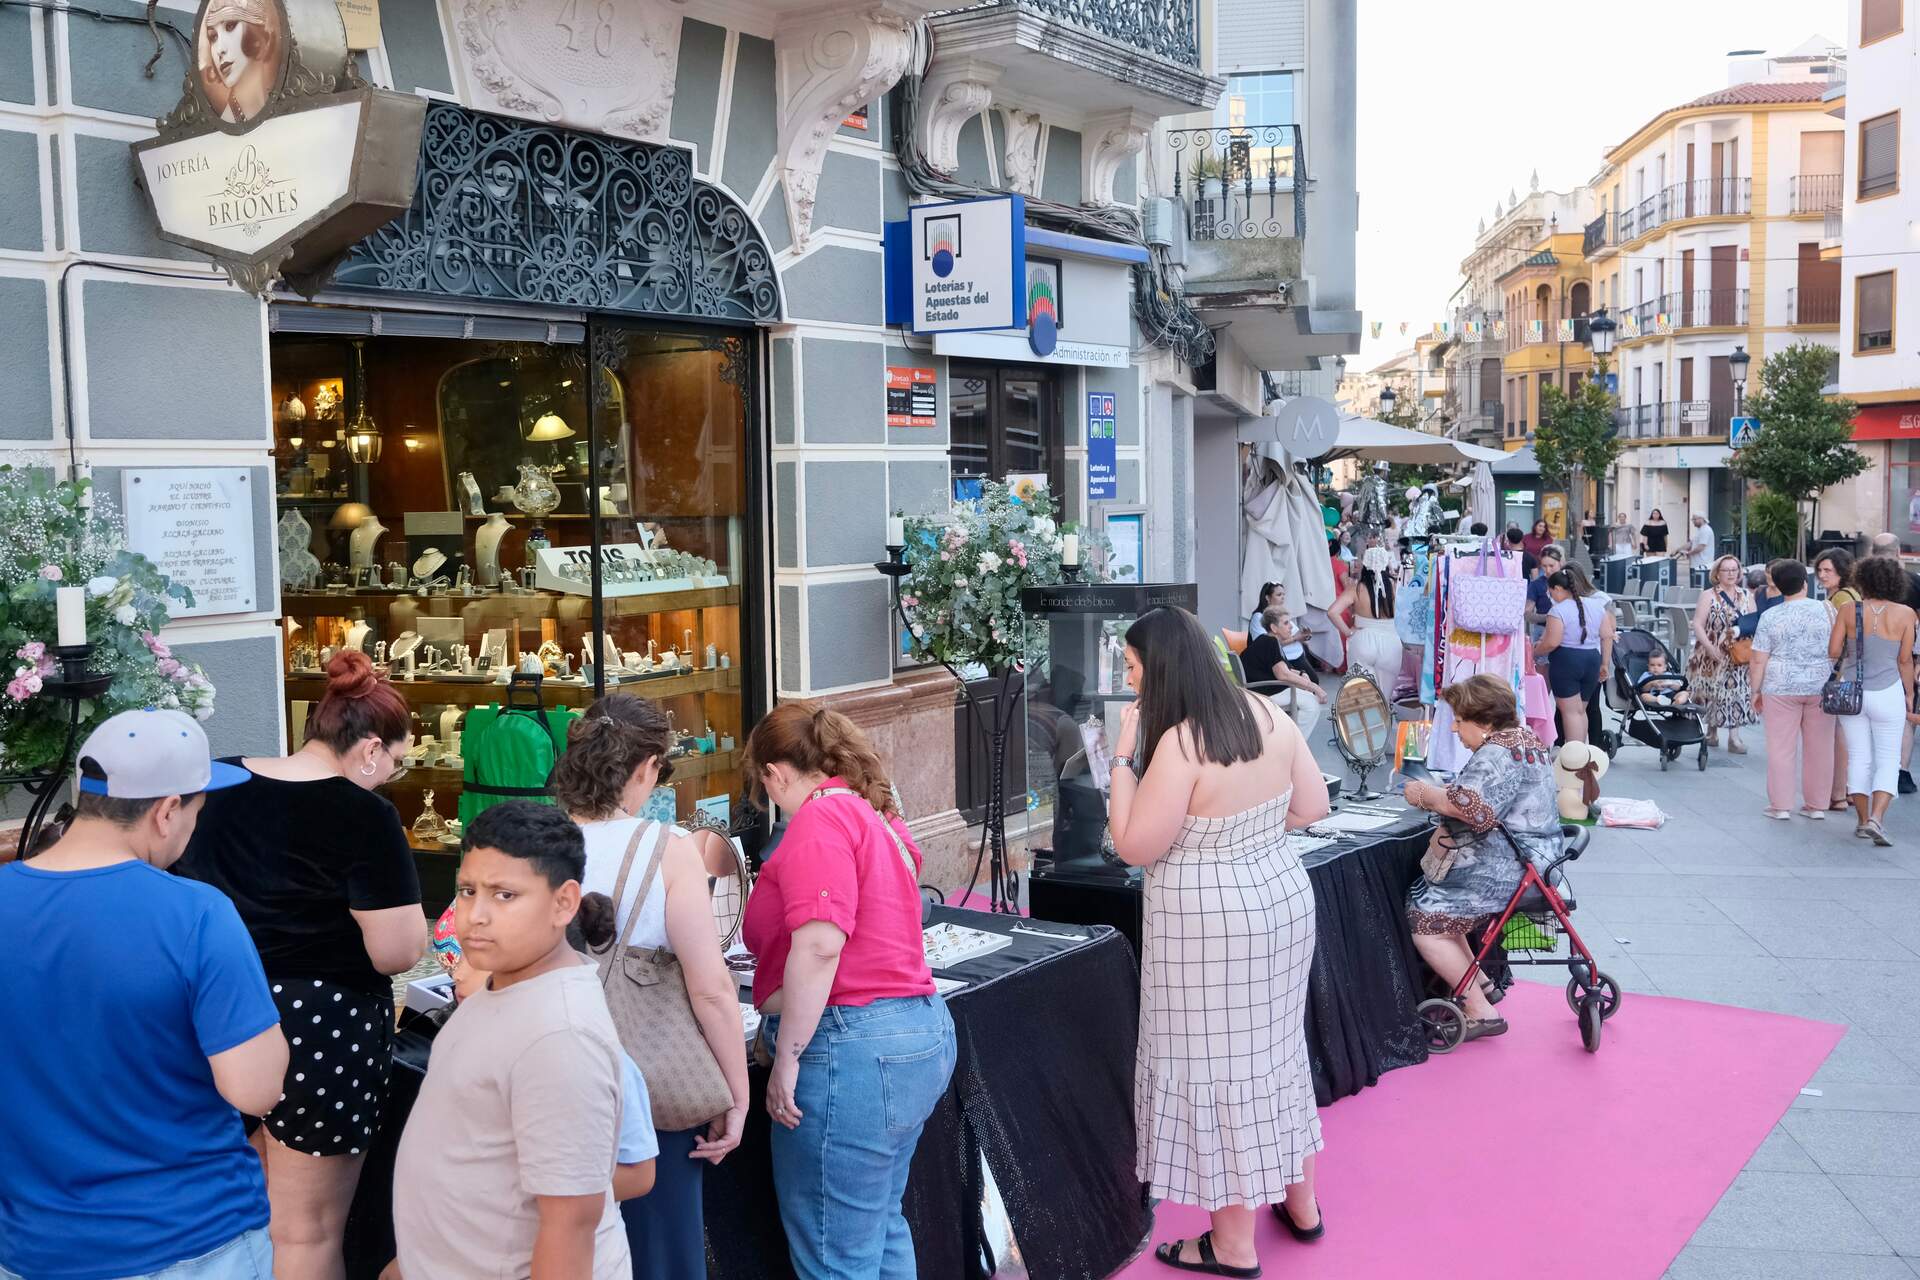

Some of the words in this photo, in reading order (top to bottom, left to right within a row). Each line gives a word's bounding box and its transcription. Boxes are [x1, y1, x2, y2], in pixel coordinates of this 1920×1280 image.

[157, 152, 210, 184] JOYERÍA
[208, 188, 299, 226] BRIONES
[967, 281, 974, 293] y
[926, 294, 971, 310] Apuestas
[974, 291, 989, 305] del
[926, 309, 959, 322] Estado
[1052, 345, 1110, 362] Administración
[1292, 413, 1324, 442] M
